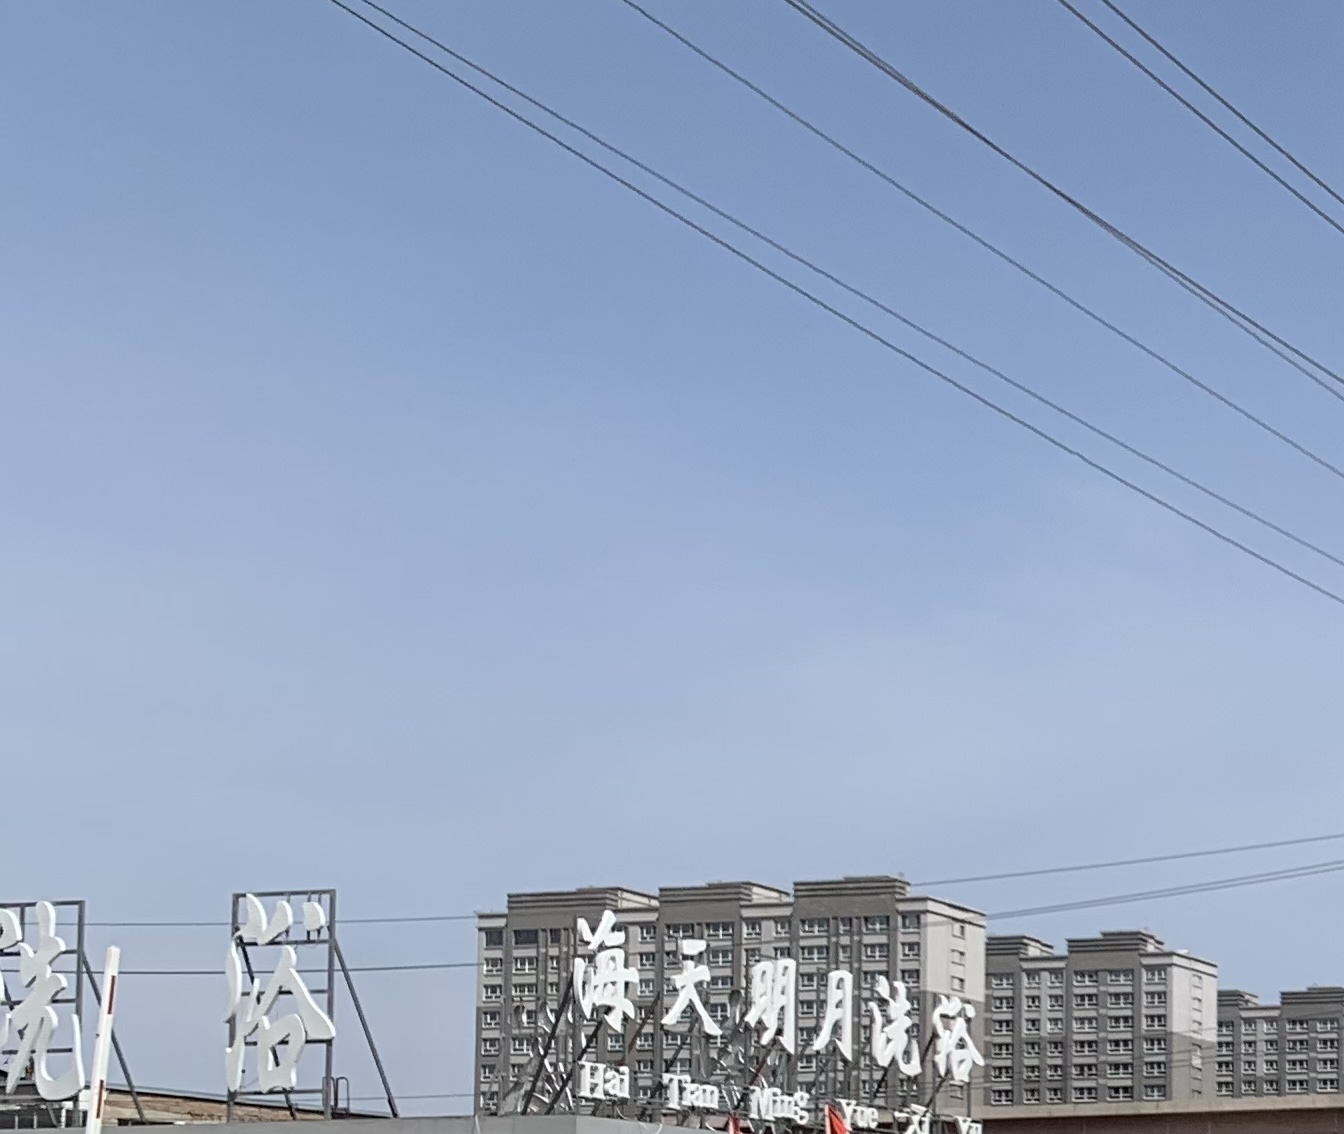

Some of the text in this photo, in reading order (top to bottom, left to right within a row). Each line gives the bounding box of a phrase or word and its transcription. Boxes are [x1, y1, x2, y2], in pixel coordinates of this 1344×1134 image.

[574, 909, 985, 1083] 海天明月洗浴
[578, 1062, 630, 1099] Hai
[662, 1073, 720, 1110] Tian
[840, 1099, 879, 1130] Yue
